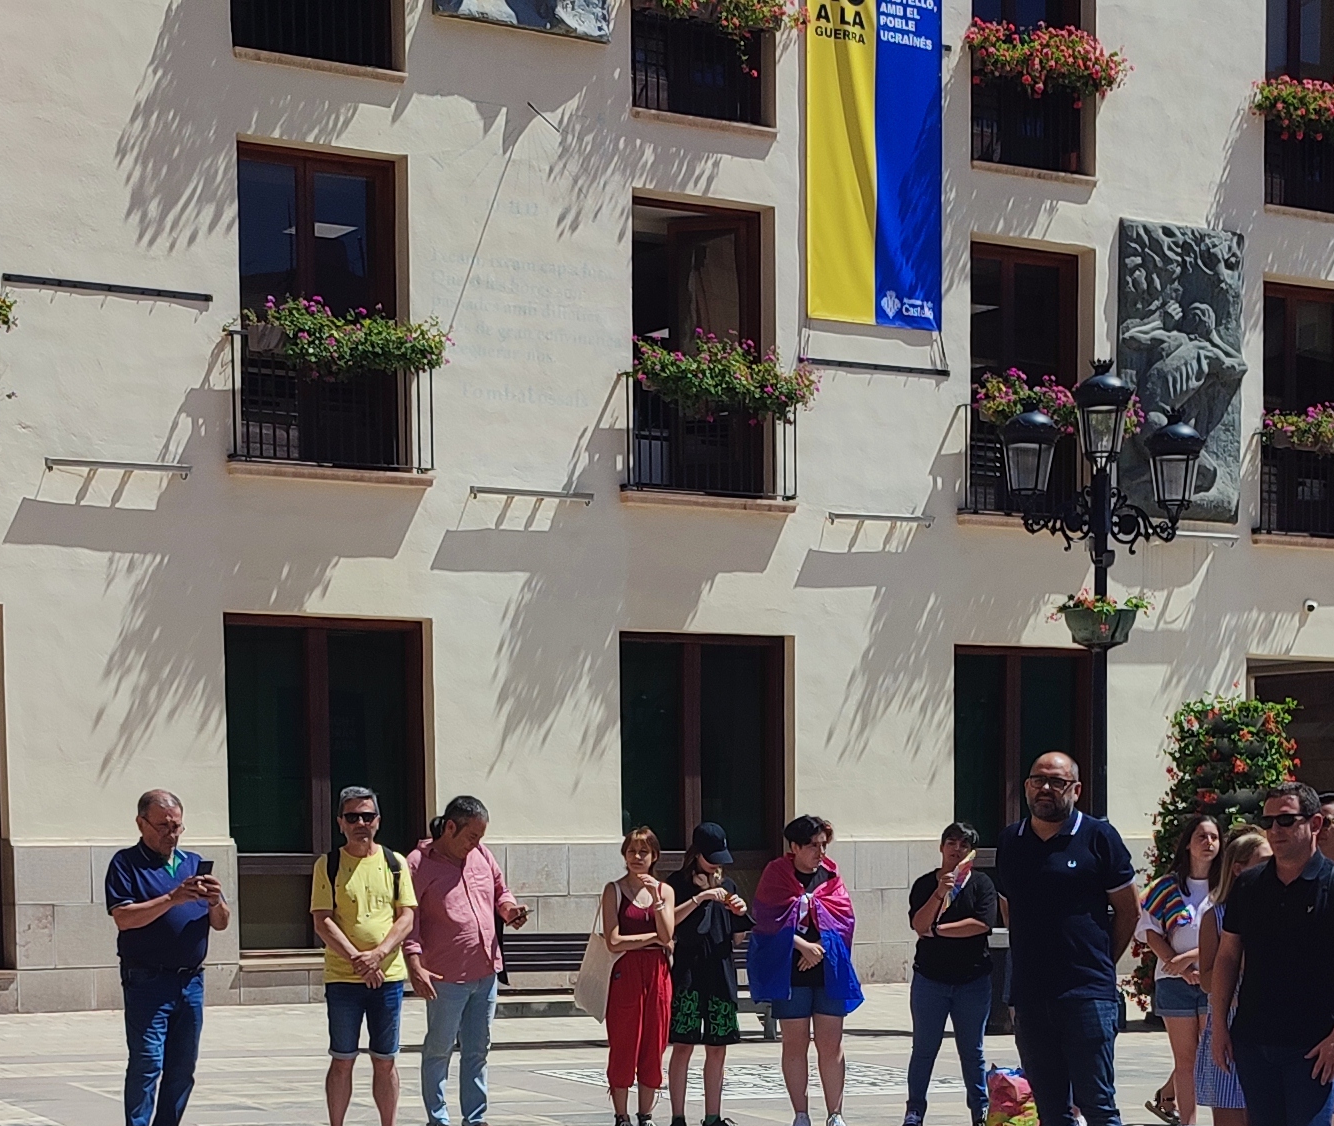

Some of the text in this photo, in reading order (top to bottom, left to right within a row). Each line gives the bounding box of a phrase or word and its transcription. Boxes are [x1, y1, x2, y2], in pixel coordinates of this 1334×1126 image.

[815, 4, 866, 30] A LA
[879, 2, 904, 16] AMB
[907, 7, 921, 19] EL
[879, 15, 916, 32] POBLE
[814, 26, 867, 45] GUERRA
